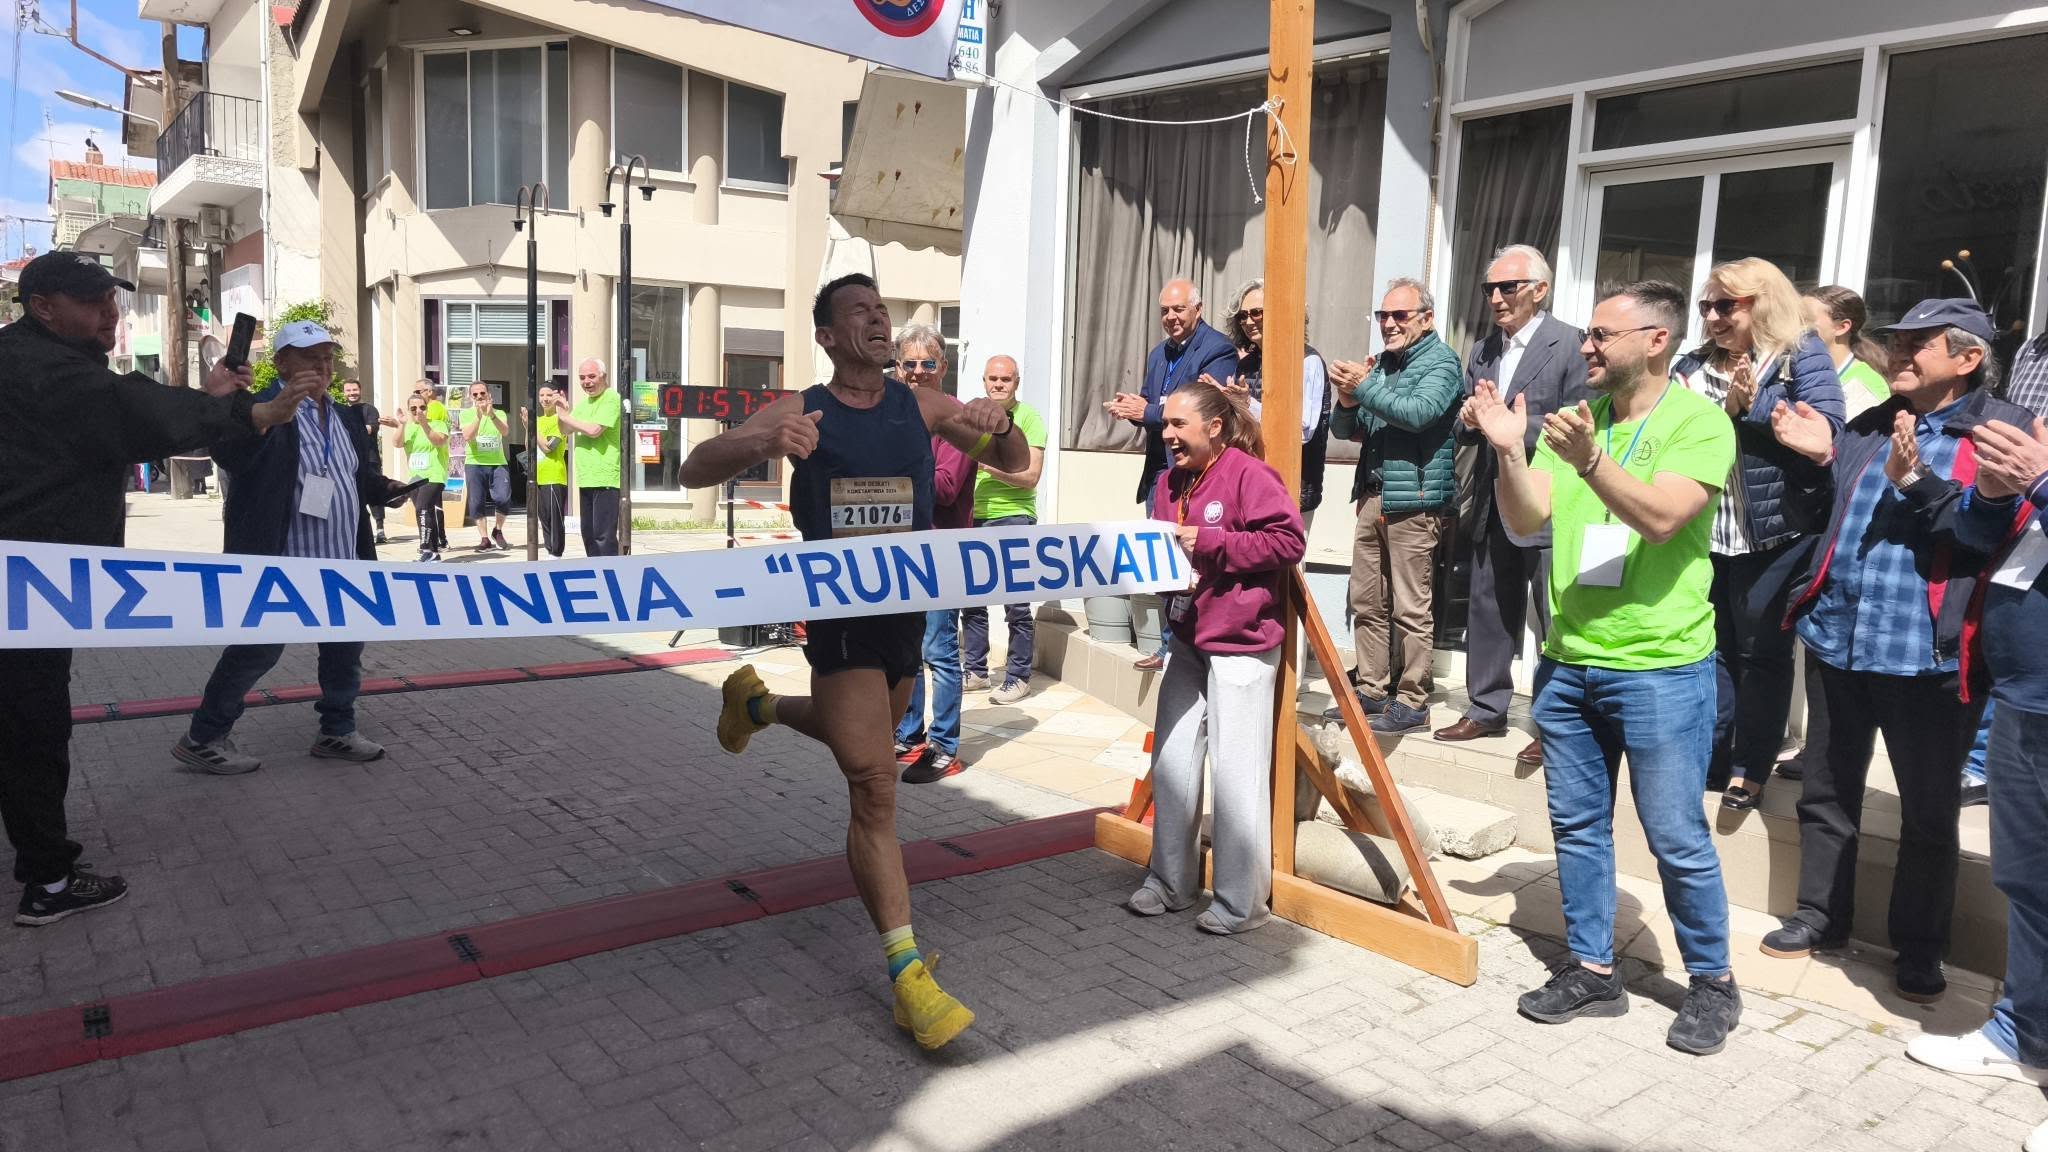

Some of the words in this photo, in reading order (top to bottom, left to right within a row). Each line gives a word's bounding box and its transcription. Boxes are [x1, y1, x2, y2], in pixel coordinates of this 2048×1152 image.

[664, 386, 793, 417] 01:57:2
[844, 505, 902, 526] 21076
[7, 555, 692, 631] ΝΣΤΑΝΤΙΝΕΙΑ
